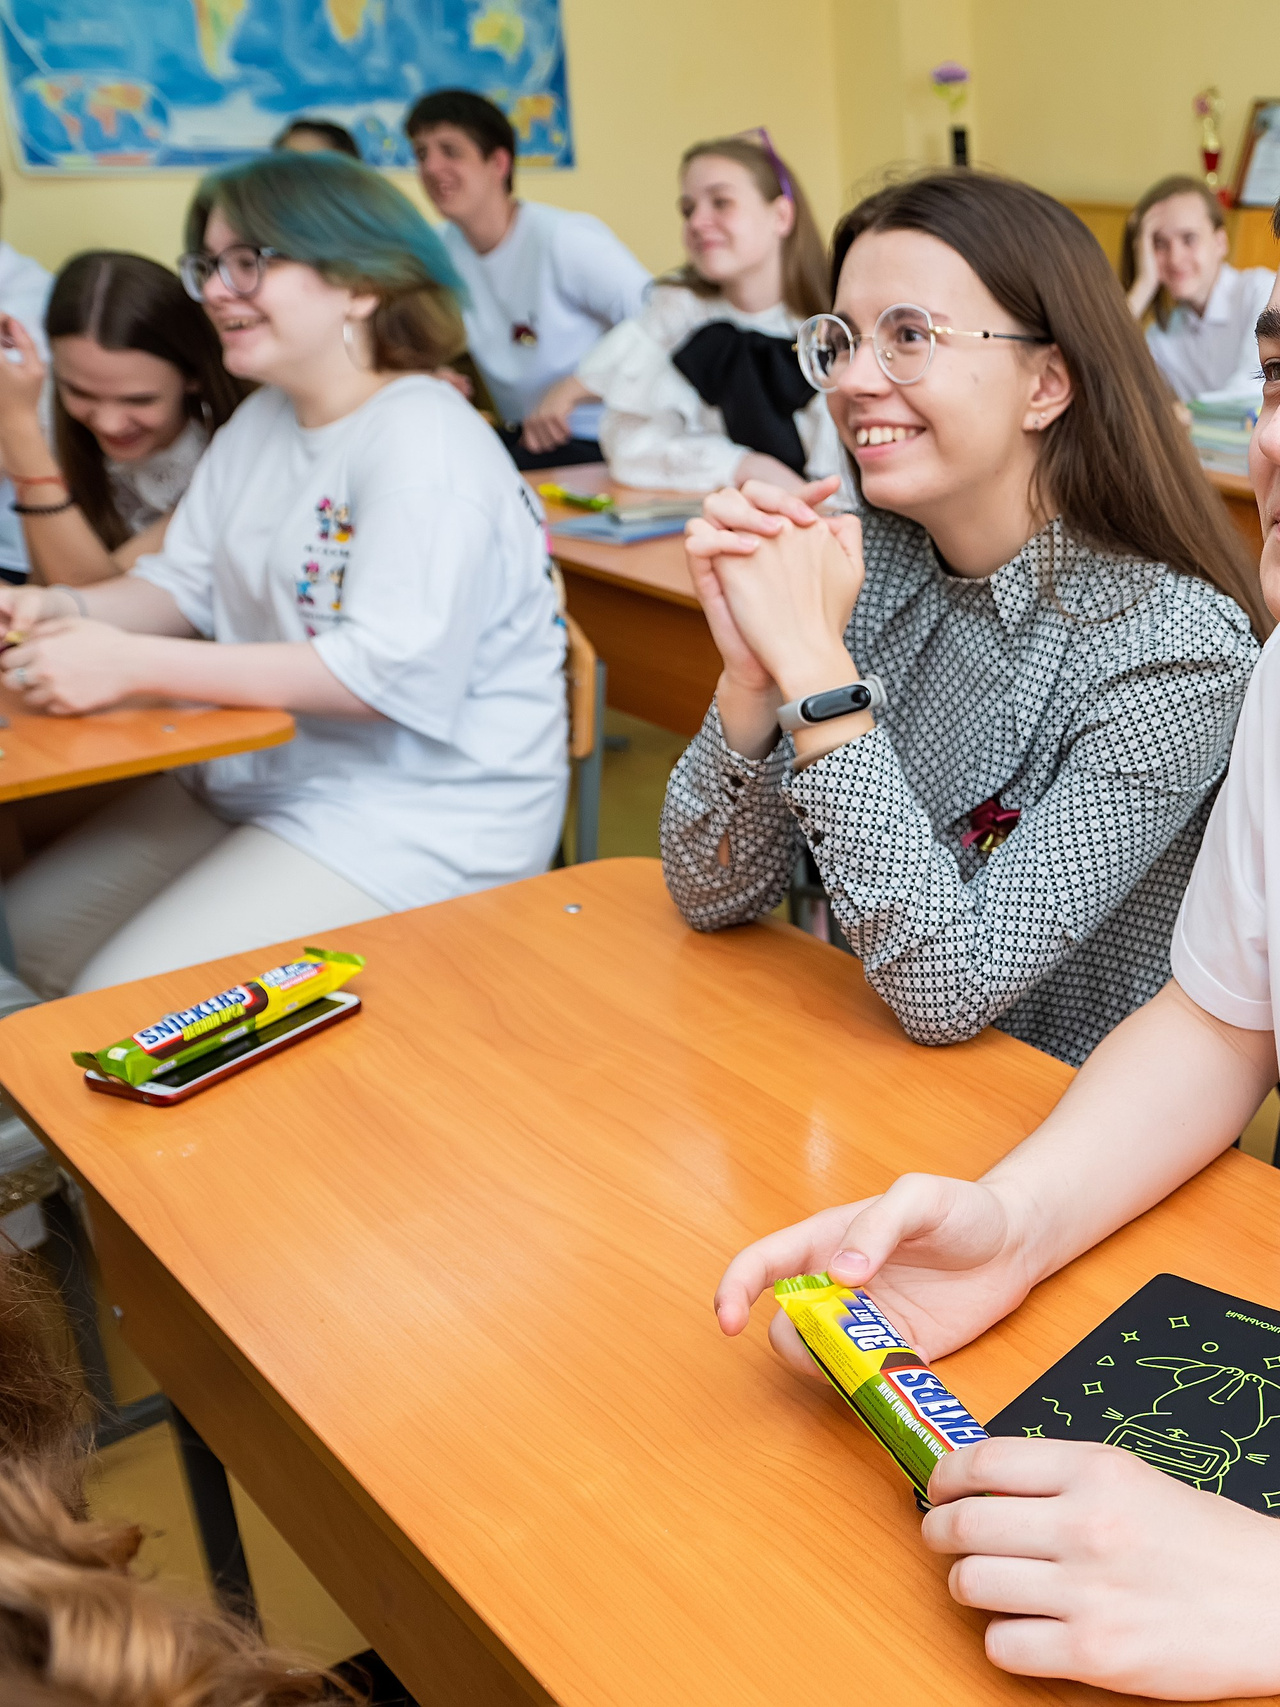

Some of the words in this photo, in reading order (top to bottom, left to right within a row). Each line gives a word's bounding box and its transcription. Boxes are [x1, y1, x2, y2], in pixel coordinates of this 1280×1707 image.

[139, 987, 246, 1045] SNICKERS
[847, 1324, 899, 1350] 30
[897, 1373, 989, 1449] CKERS
